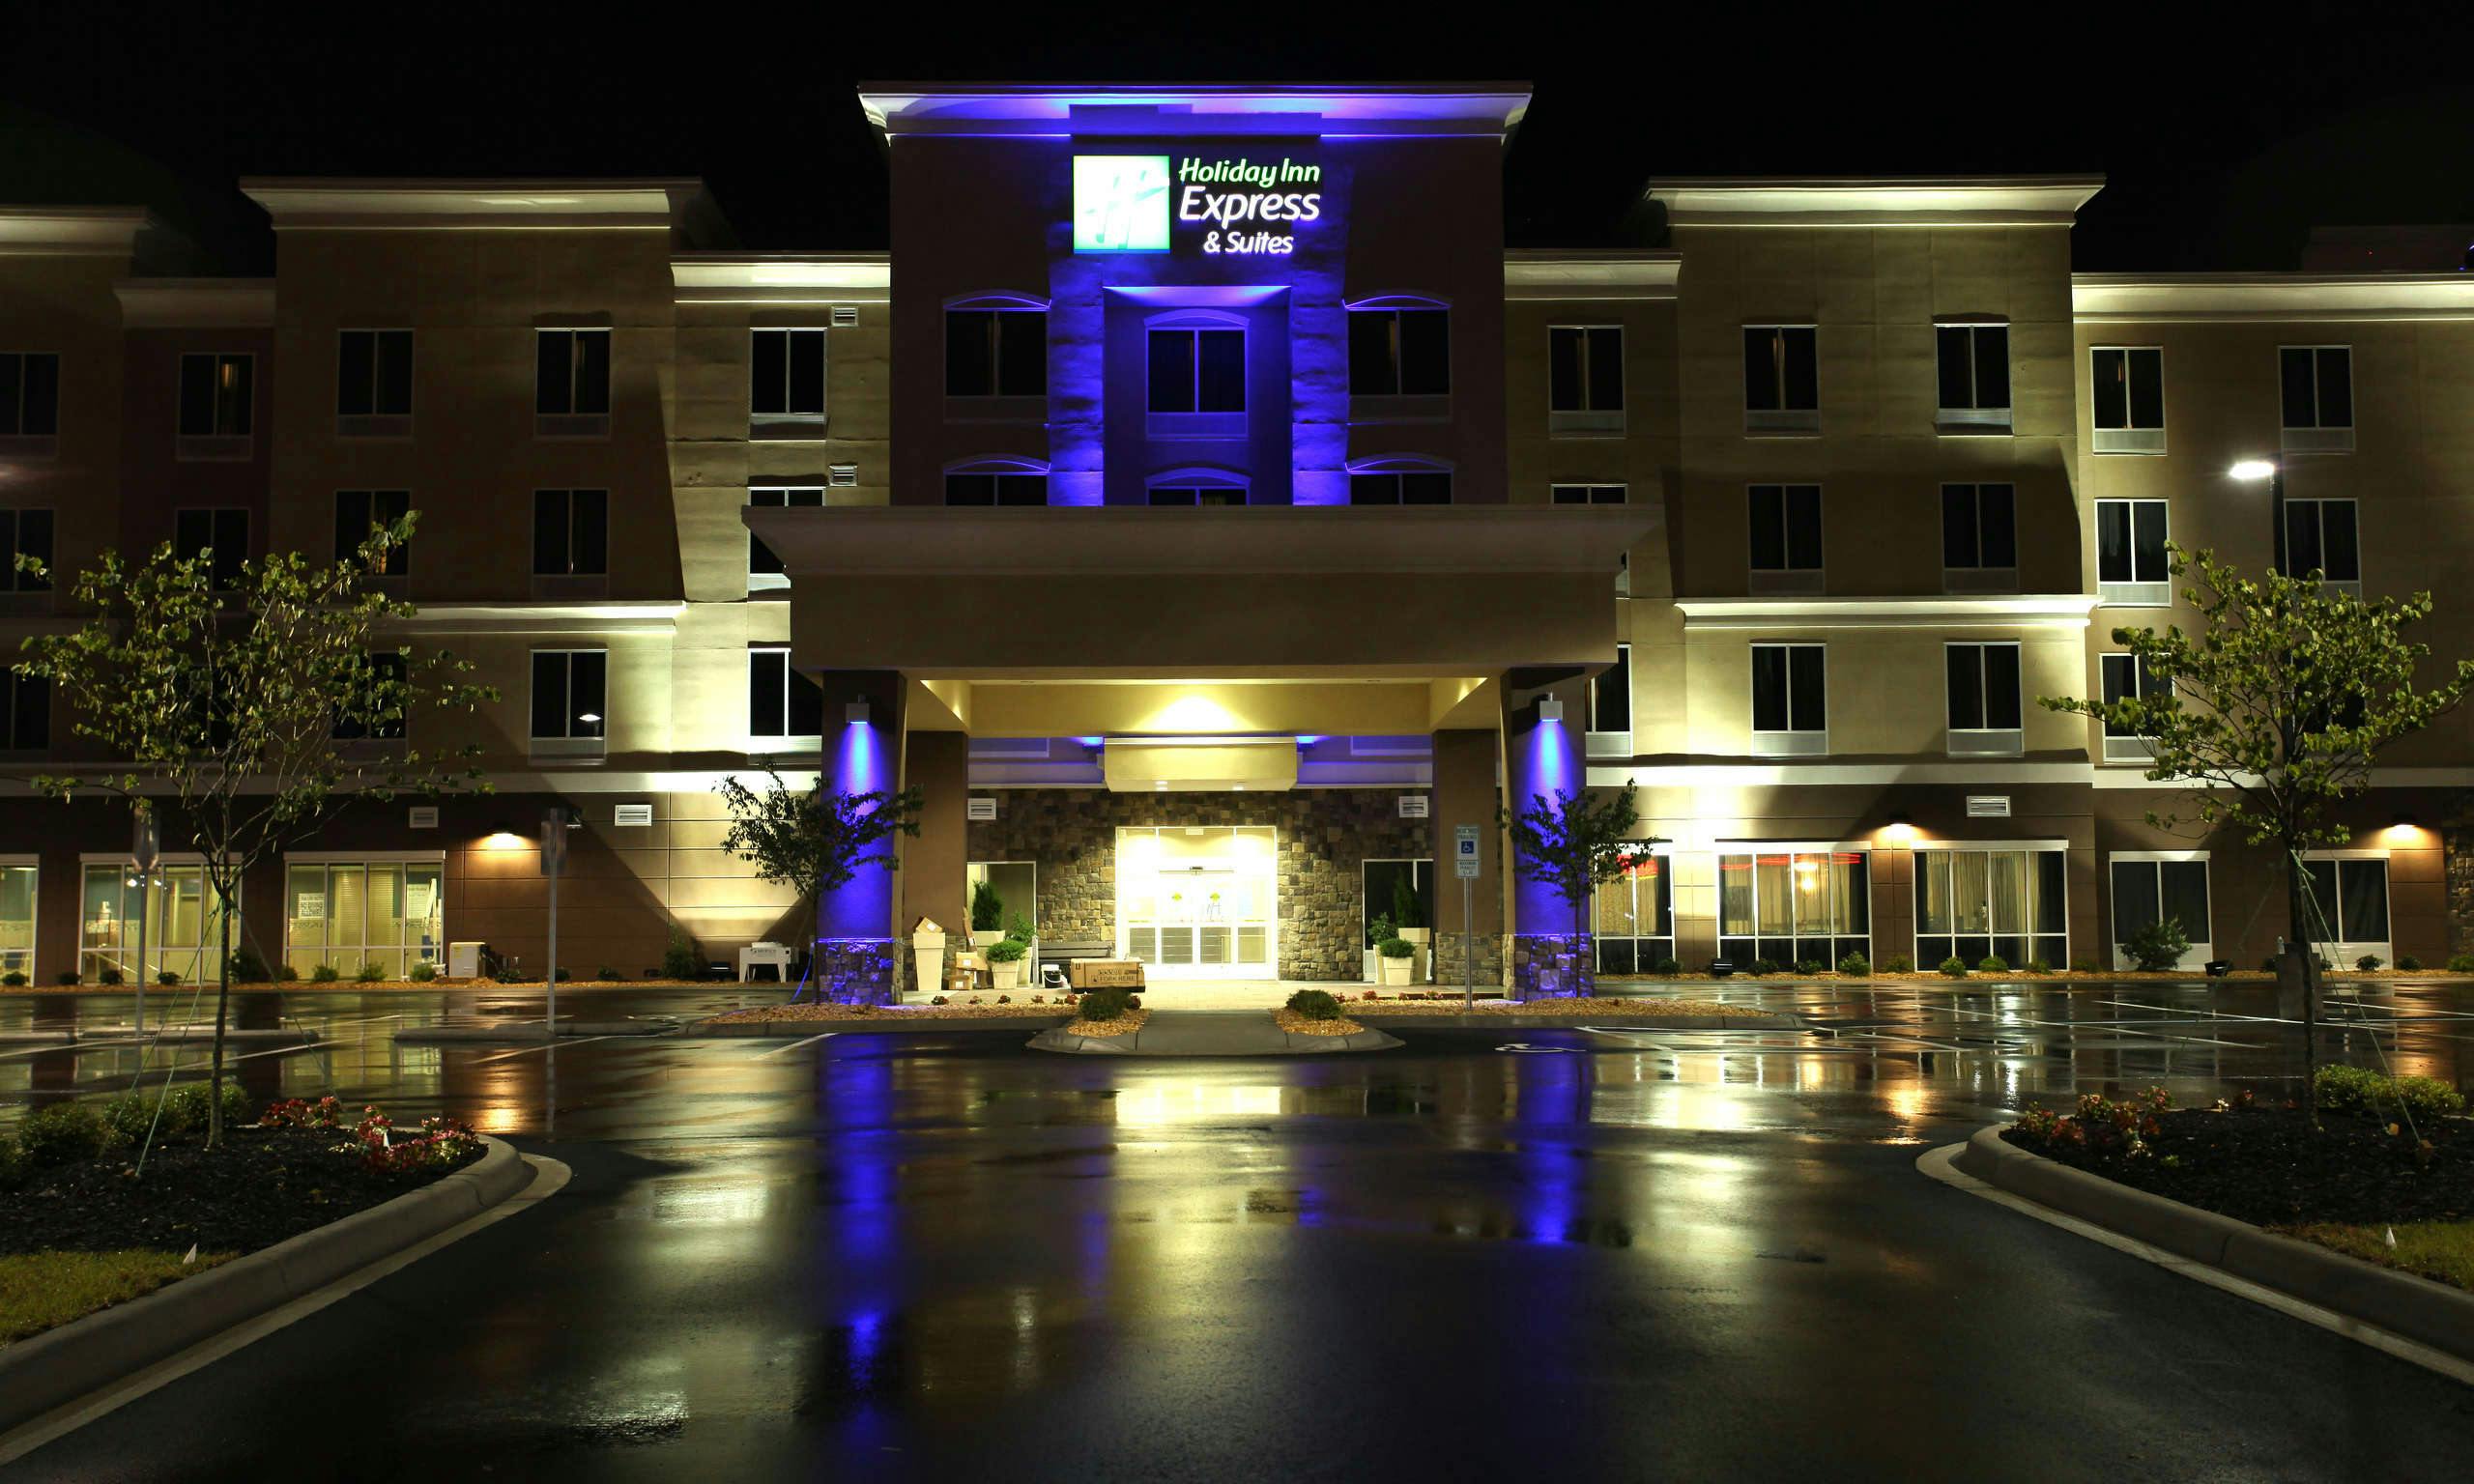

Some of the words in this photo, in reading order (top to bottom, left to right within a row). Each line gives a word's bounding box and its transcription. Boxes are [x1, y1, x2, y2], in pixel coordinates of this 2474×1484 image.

[1179, 157, 1277, 187] Holiday
[1280, 157, 1320, 183] Inn
[1179, 186, 1321, 229] Express
[1203, 231, 1222, 254] &
[1224, 231, 1294, 254] Suites
